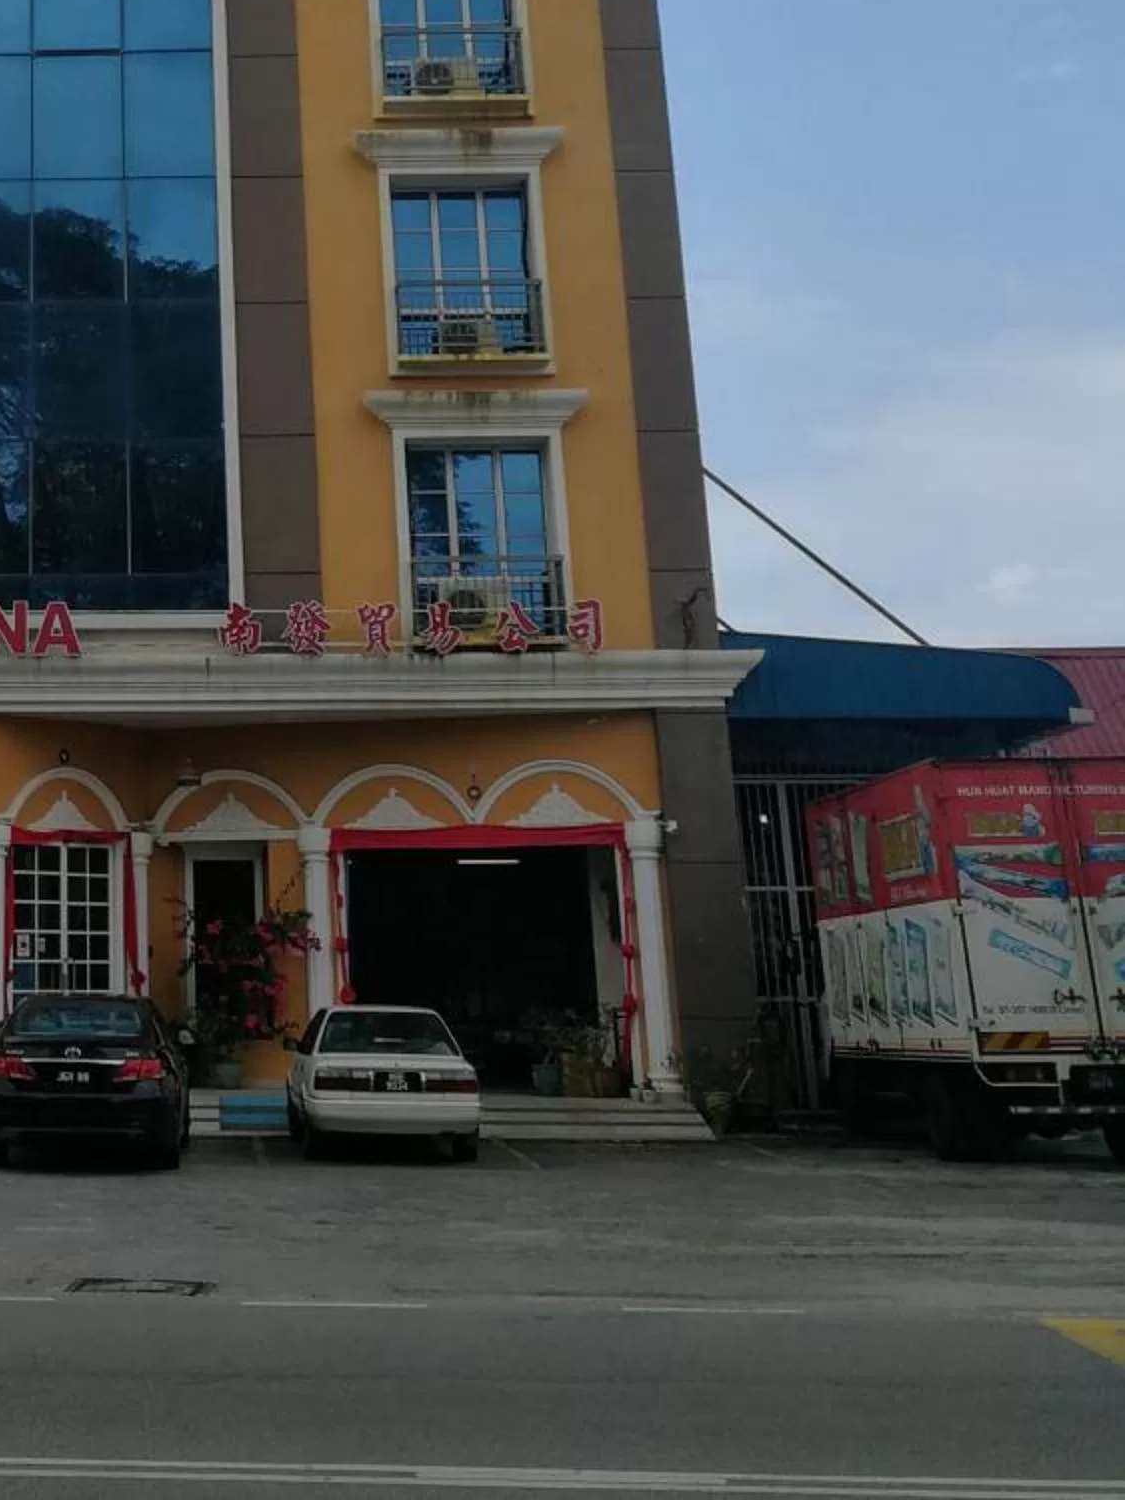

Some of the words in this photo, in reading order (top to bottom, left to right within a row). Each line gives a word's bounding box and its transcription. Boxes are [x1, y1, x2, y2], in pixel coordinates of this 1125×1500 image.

[217, 600, 604, 655] 南發貿易公司
